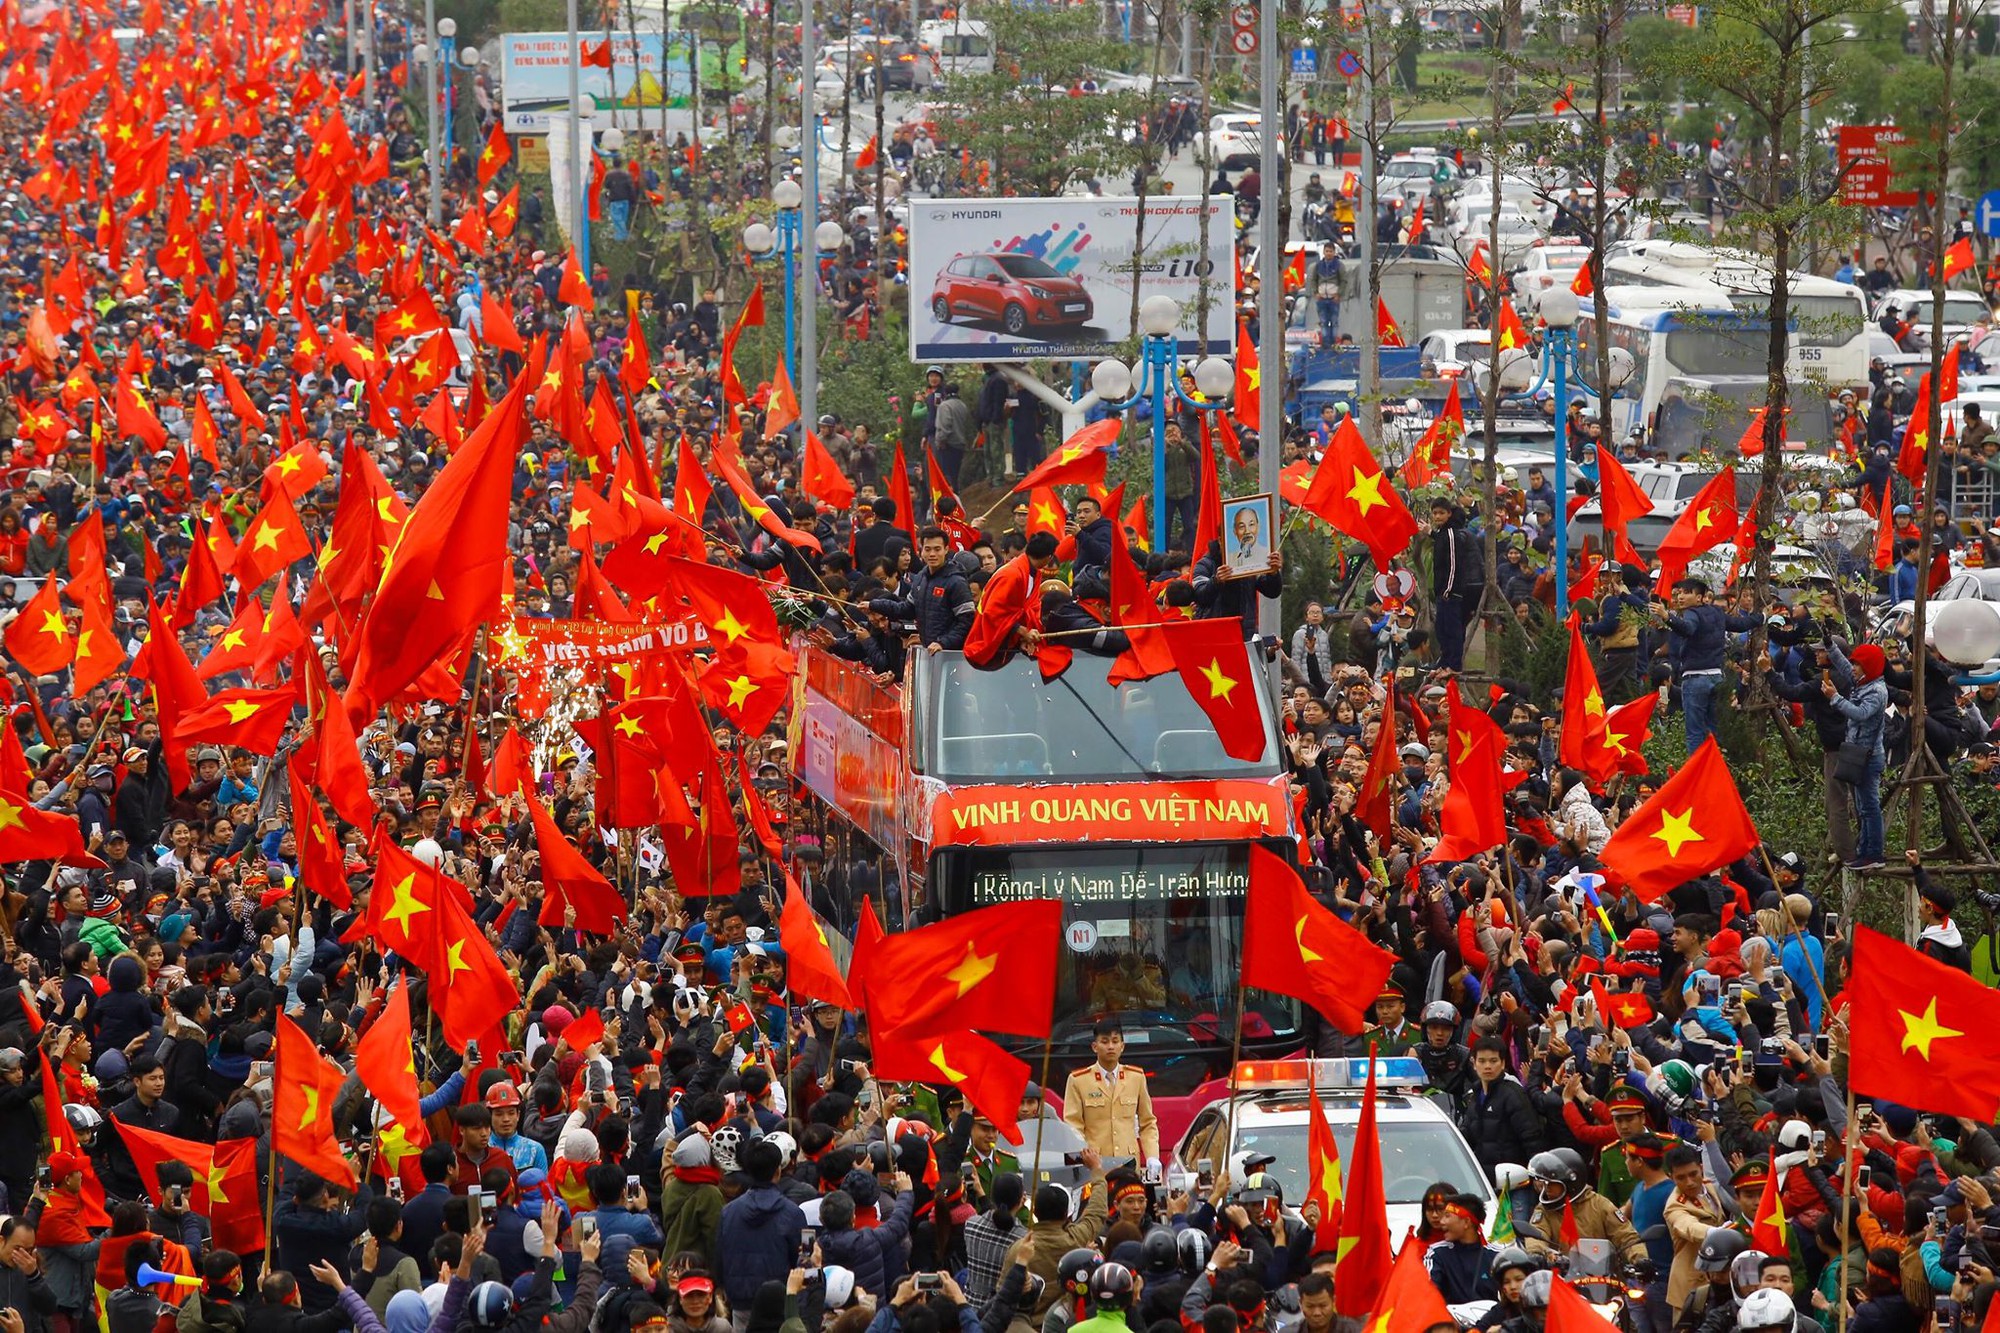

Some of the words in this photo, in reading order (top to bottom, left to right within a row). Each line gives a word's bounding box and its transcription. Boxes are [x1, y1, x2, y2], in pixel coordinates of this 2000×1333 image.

[952, 210, 1002, 219] HYUNDAI
[951, 801, 1021, 829] VINH
[1030, 799, 1132, 823] QUANG
[1139, 793, 1200, 827] VIỆT
[1205, 800, 1270, 826] NAM
[1073, 929, 1090, 943] N1
